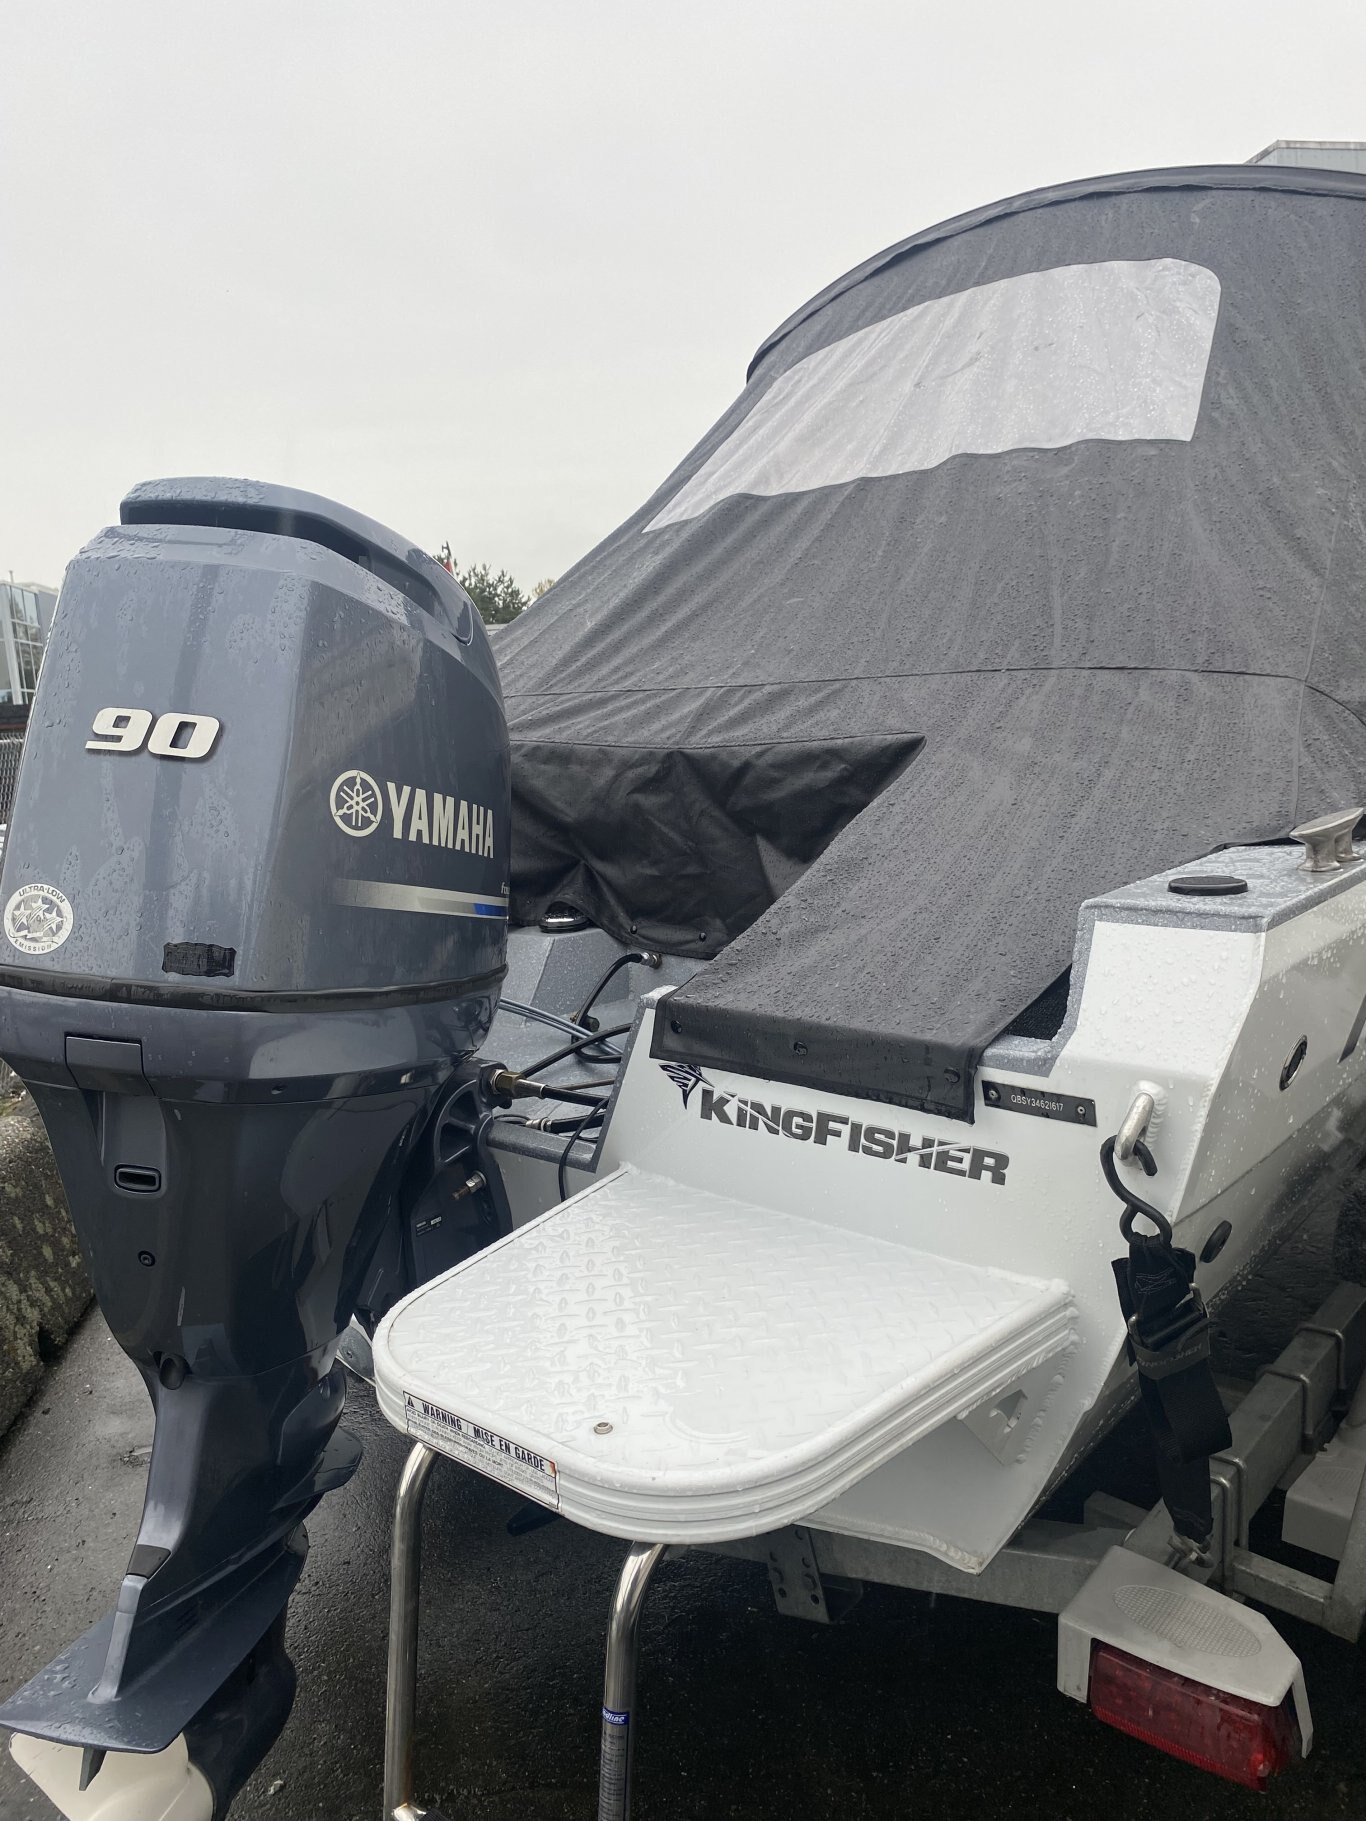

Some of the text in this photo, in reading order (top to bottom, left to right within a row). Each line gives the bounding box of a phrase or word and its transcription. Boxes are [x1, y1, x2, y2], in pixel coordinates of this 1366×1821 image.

[85, 708, 220, 759] 90
[387, 781, 494, 859] YAMAHA
[700, 1087, 1010, 1186] KINGFISHER
[422, 1403, 462, 1431] WARNING
[473, 1426, 496, 1447] MISE
[499, 1438, 511, 1455] EN
[515, 1446, 545, 1472] GARDE
